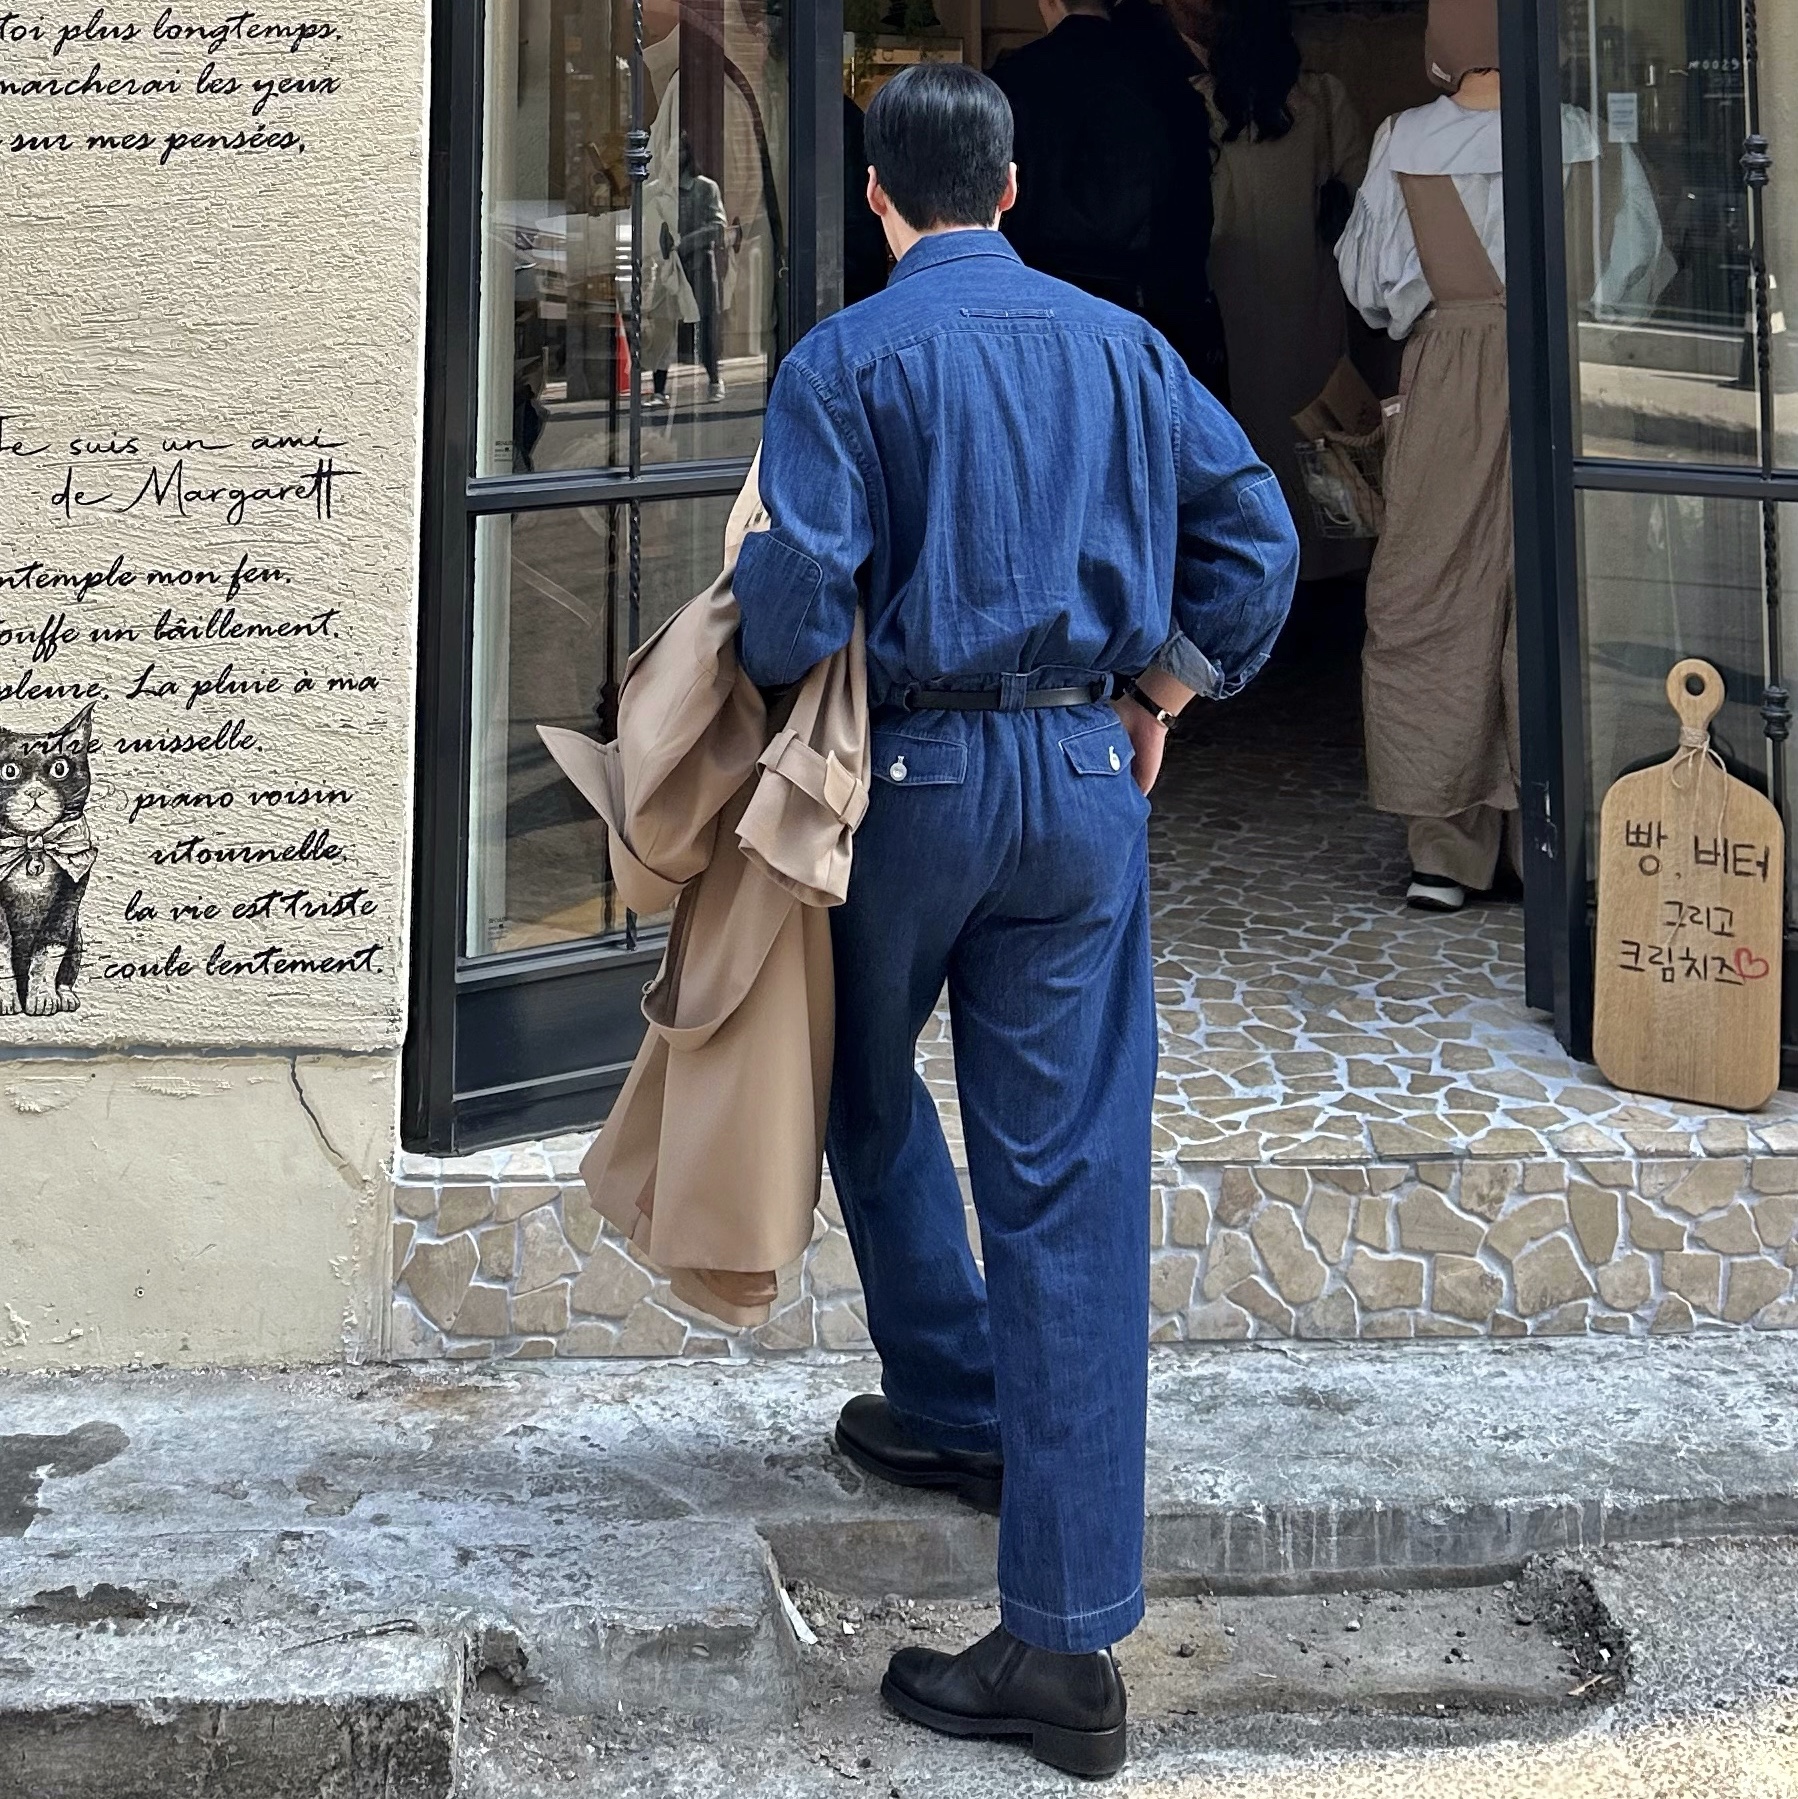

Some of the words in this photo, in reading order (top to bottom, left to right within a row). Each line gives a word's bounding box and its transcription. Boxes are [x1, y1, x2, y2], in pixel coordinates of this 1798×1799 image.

[0, 12, 47, 41] toi
[53, 8, 141, 56] plus
[153, 8, 341, 54] longtemps.
[198, 62, 243, 96] les
[252, 76, 341, 116] yeux
[10, 133, 74, 152] sur
[87, 132, 154, 150] mes
[69, 431, 140, 455] suis
[162, 437, 234, 453] un
[251, 428, 347, 449] ami
[51, 466, 113, 520] de
[114, 458, 362, 526] Margarett
[147, 570, 221, 587] mon
[227, 554, 292, 602] feu.
[0, 612, 80, 662] ouffe
[89, 629, 140, 642] un
[153, 609, 340, 643] bâillement.
[126, 663, 180, 699] La
[186, 663, 284, 710] pluie
[294, 670, 315, 690] à
[328, 673, 379, 690] ma
[113, 718, 264, 755] ruisselle.
[129, 790, 235, 824] piano
[248, 779, 353, 806] voisin
[1694, 835, 1770, 883] 버터
[124, 889, 157, 921] la
[170, 896, 220, 920] vie
[232, 889, 283, 919] est
[280, 888, 379, 918] triste
[1663, 900, 1736, 937] 그리고
[104, 945, 193, 978] coule
[206, 944, 384, 976] lentement.
[1618, 939, 1744, 985] 크림치즈
